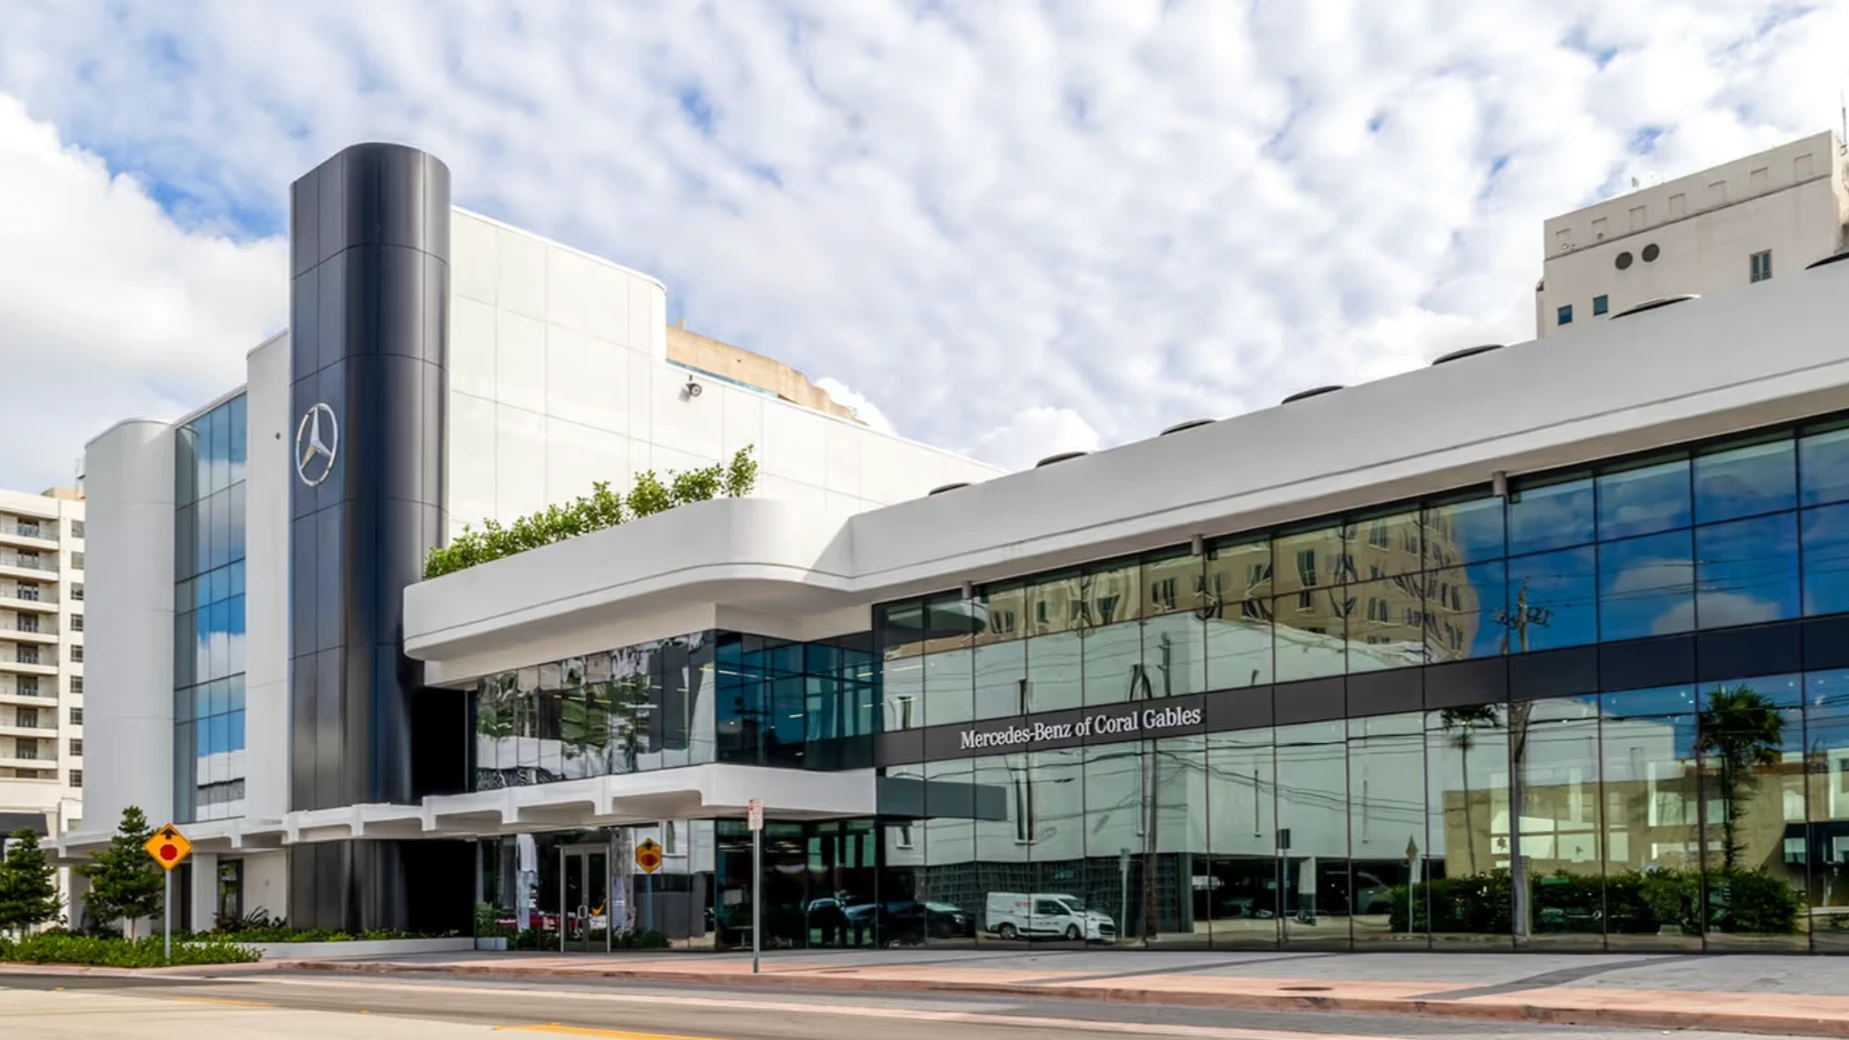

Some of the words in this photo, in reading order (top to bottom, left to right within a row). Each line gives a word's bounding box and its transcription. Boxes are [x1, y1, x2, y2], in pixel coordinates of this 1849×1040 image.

[960, 723, 1072, 750] Mercedes-Benz
[1075, 717, 1092, 736] of
[1094, 711, 1138, 733] Coral
[1142, 706, 1201, 729] Gables
